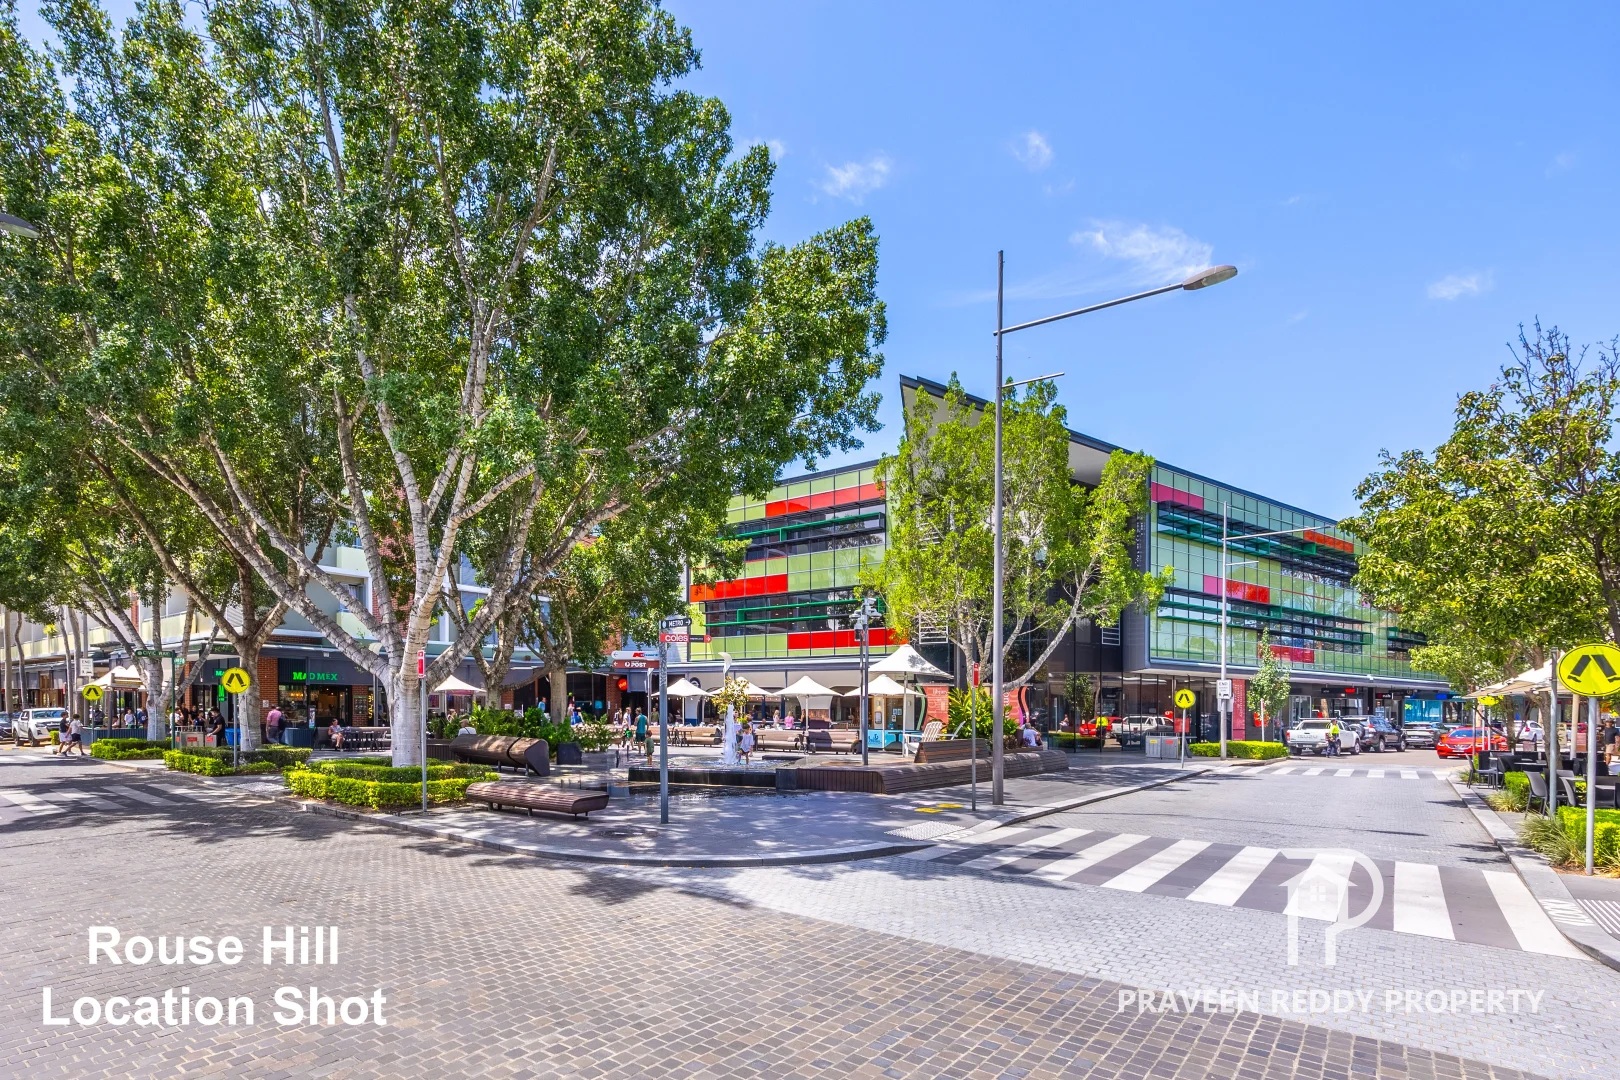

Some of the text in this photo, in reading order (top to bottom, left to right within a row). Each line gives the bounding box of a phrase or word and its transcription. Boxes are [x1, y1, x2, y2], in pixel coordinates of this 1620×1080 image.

[668, 619, 684, 627] METRO
[664, 633, 689, 642] coles
[316, 672, 338, 681] MEX
